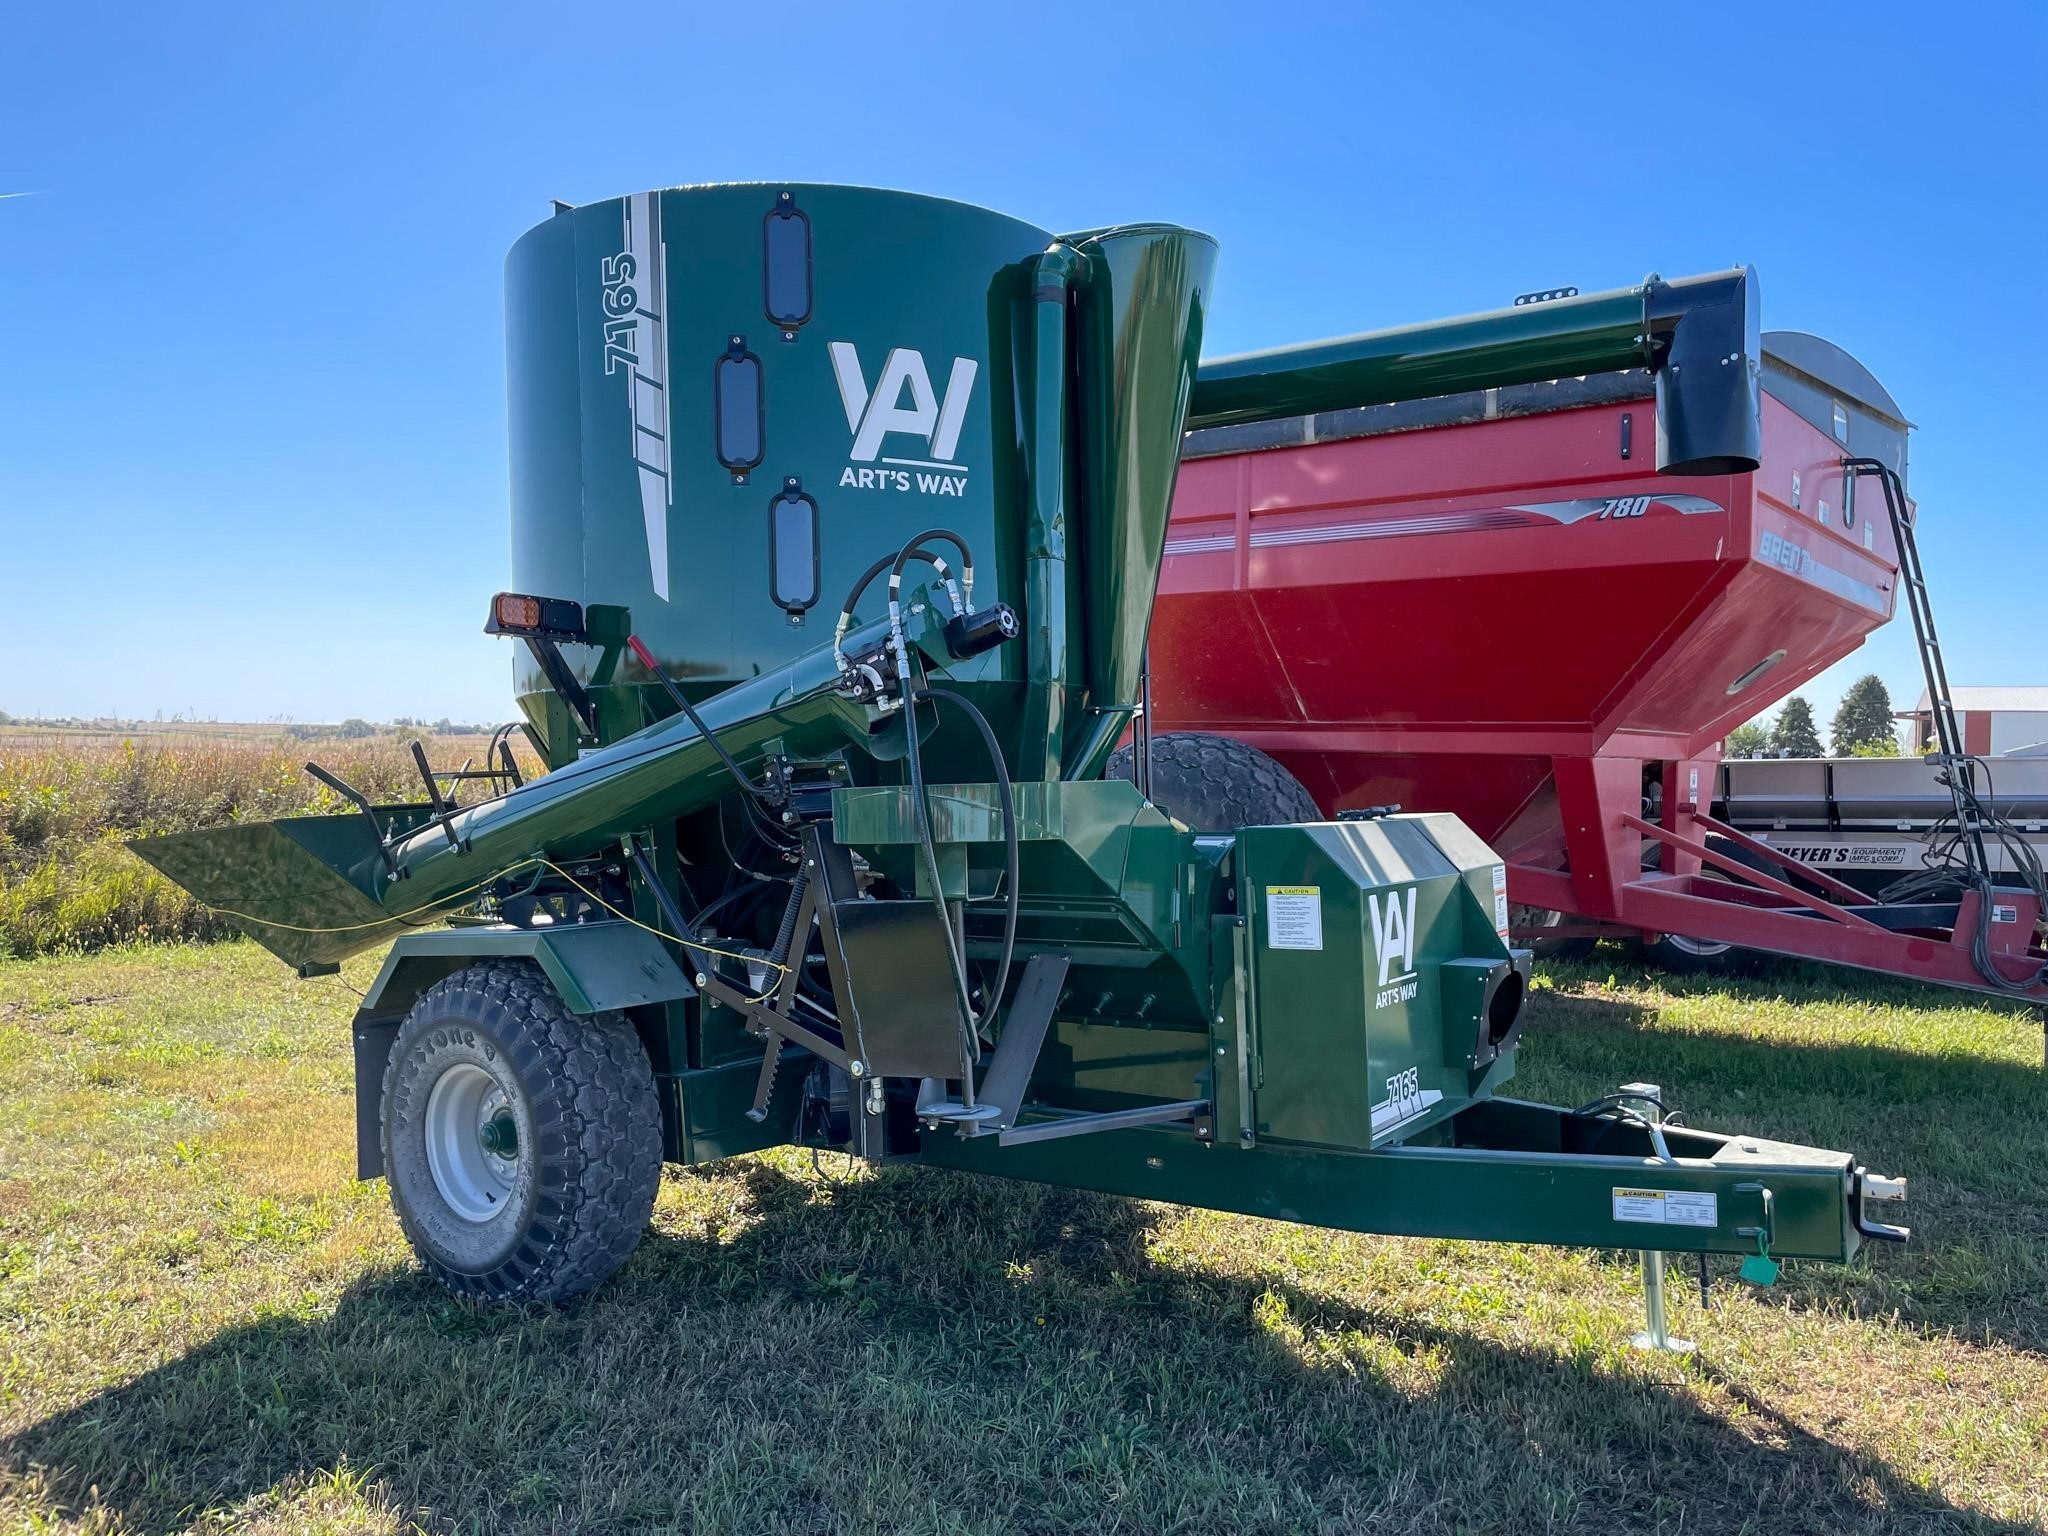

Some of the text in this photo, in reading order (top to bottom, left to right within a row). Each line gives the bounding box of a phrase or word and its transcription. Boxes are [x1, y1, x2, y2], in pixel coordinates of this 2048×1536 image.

[602, 252, 638, 375] 7165
[839, 467, 967, 497] ART'S WAY
[1600, 496, 1651, 520] 780
[1375, 981, 1418, 1010] ART'S WAY
[1386, 1066, 1418, 1107] 7165
